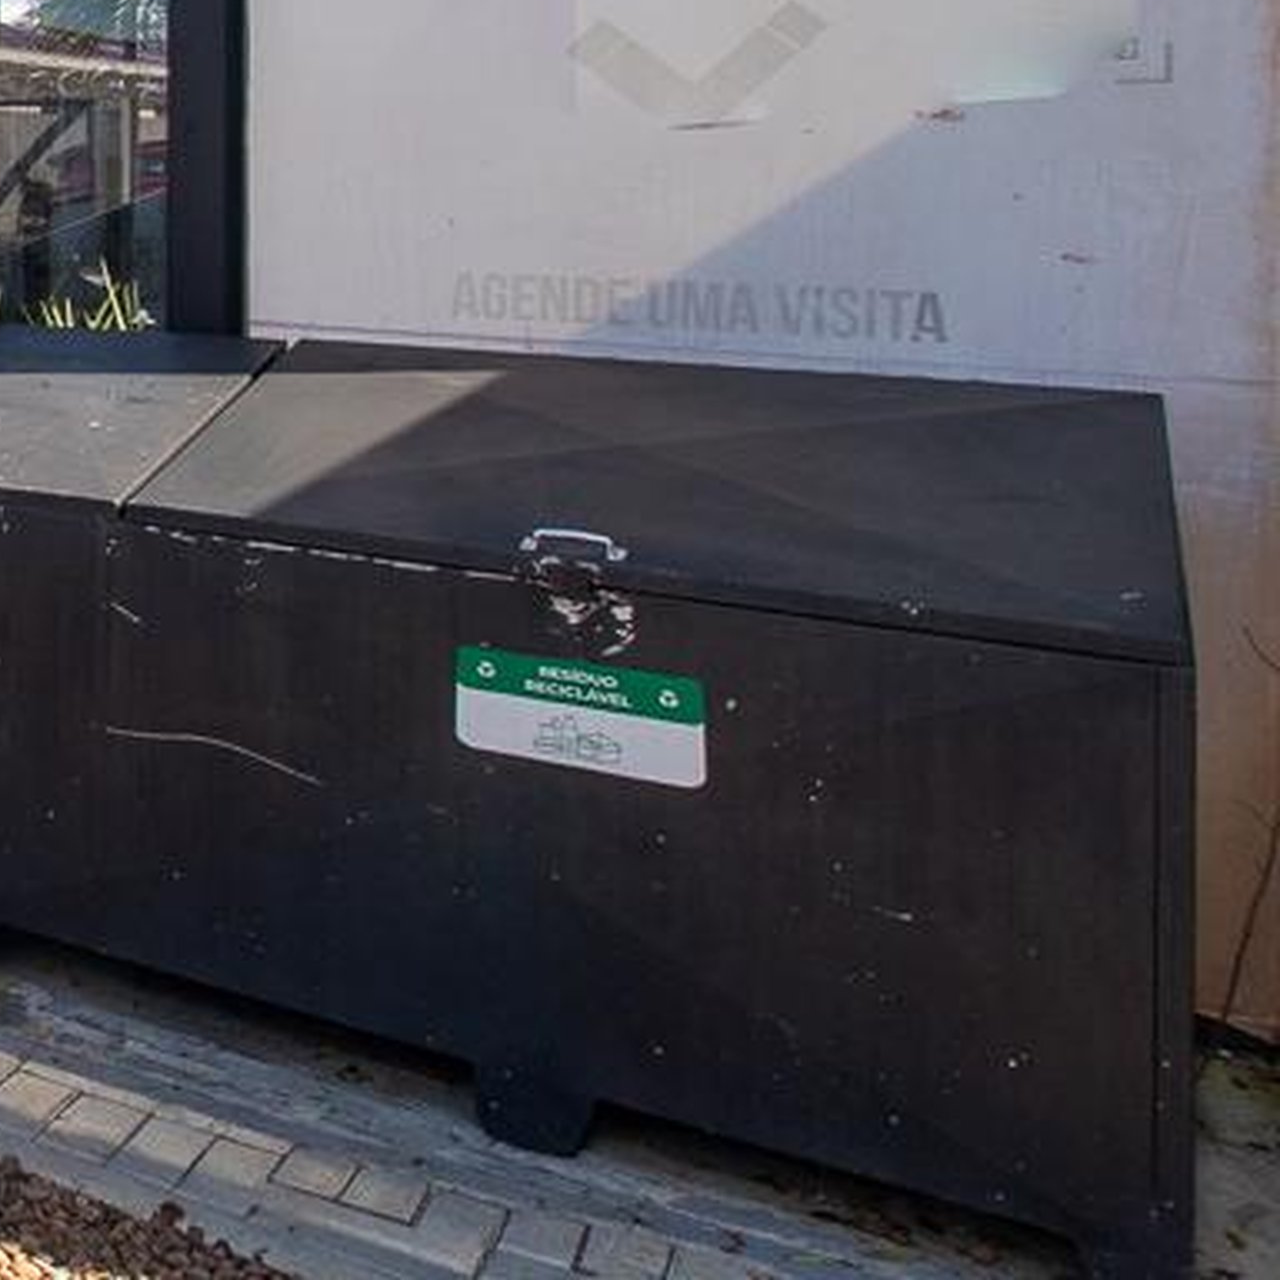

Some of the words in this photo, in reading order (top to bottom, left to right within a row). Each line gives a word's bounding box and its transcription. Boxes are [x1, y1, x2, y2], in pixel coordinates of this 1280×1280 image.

[452, 269, 634, 328] AGENDE
[644, 280, 761, 334] UMA
[777, 286, 949, 344] VISITA
[539, 666, 618, 688] RESÍDUO
[524, 679, 632, 707] RECICLÁVEL
